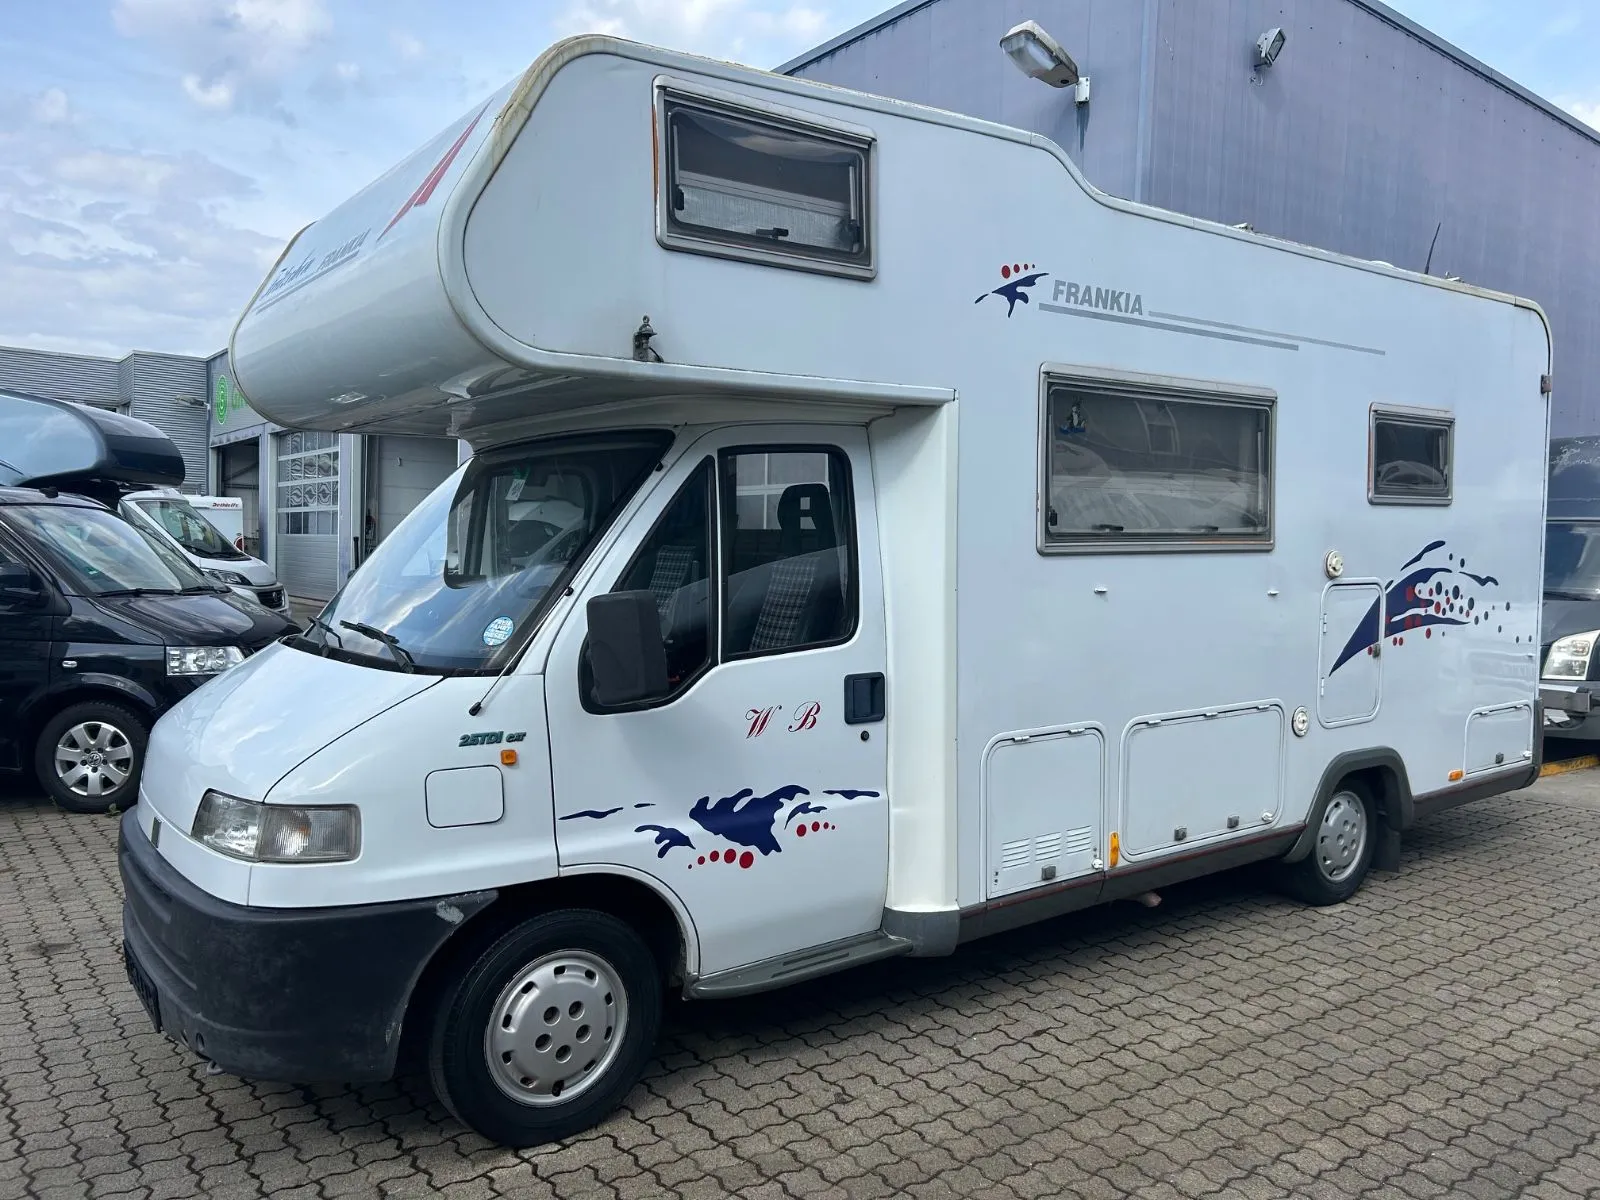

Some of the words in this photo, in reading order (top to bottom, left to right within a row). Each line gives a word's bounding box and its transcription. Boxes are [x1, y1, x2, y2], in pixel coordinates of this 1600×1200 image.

[1052, 279, 1143, 315] FRANKIA
[744, 704, 783, 739] W
[787, 701, 821, 733] B
